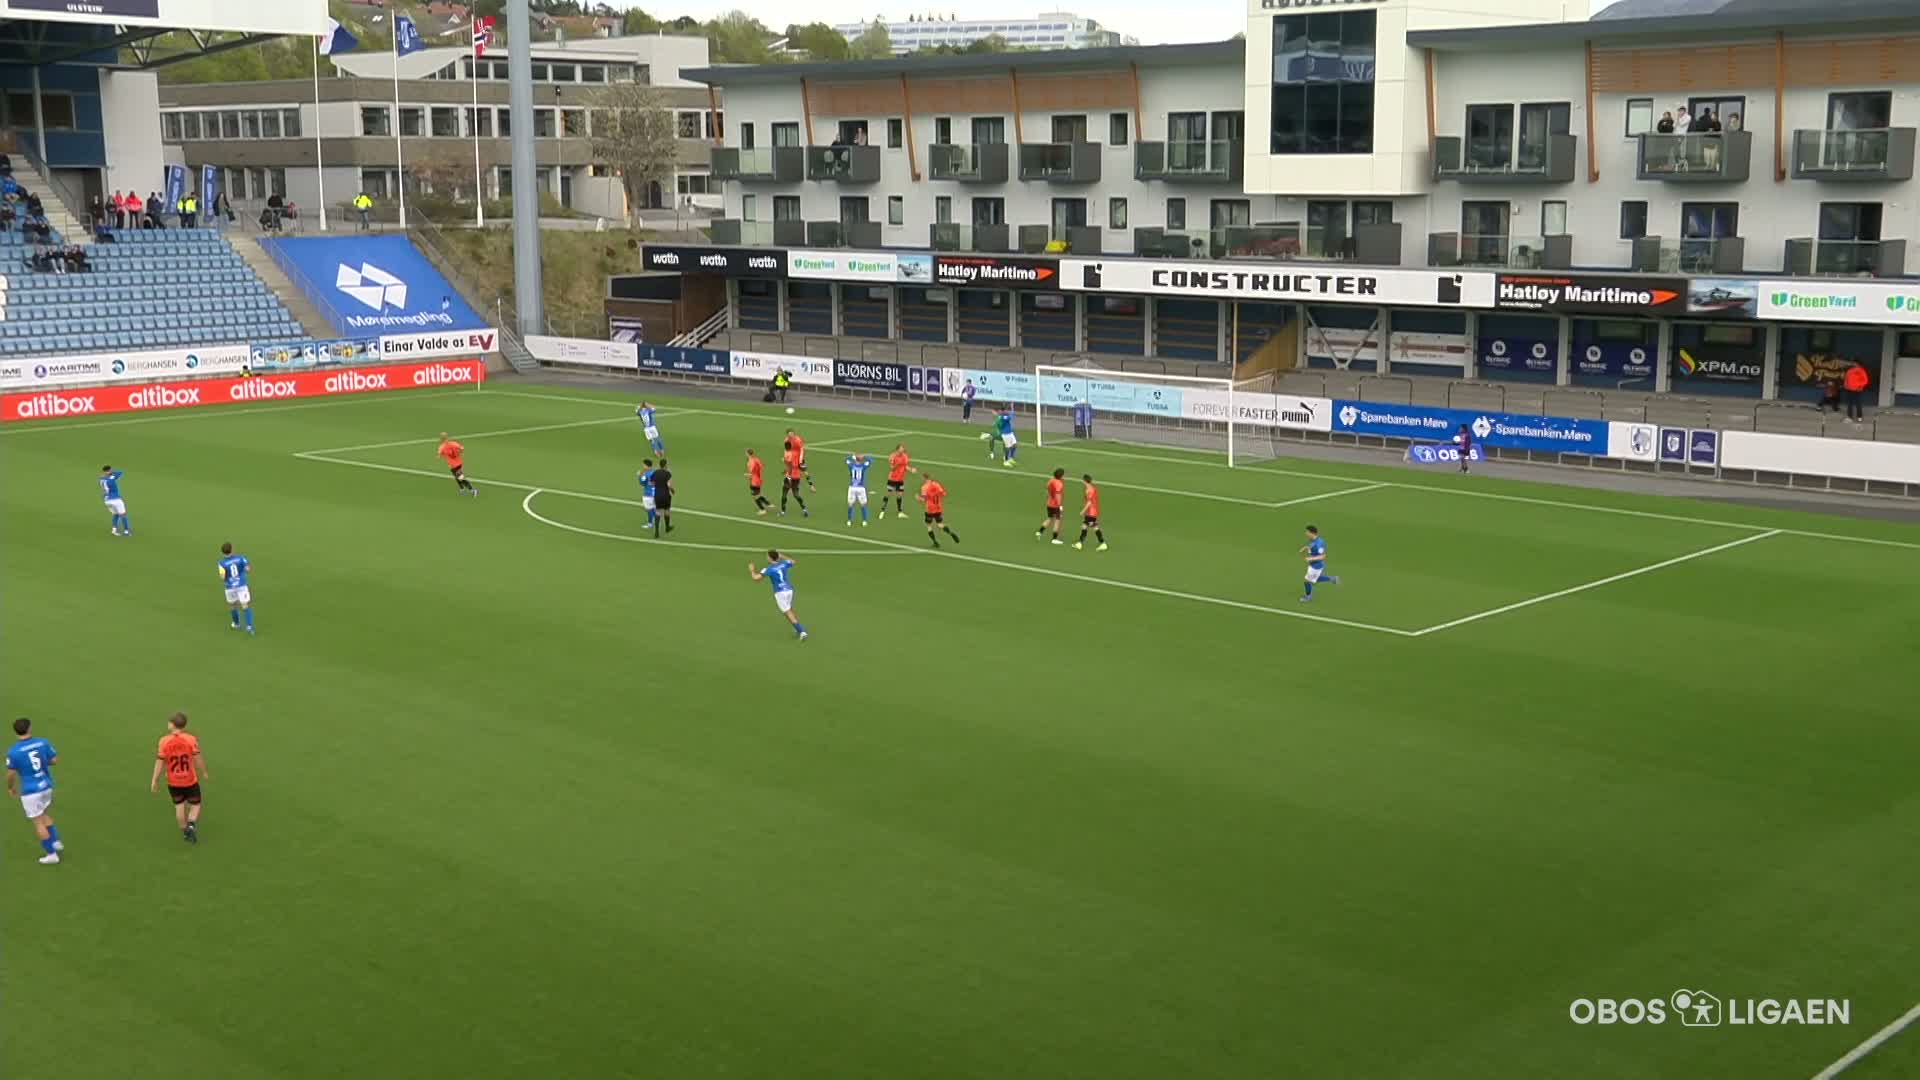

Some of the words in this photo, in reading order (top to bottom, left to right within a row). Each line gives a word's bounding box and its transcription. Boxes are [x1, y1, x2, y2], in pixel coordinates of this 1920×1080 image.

[980, 265, 1036, 280] Maritime
[1152, 269, 1377, 296] CONSTRUCTER
[1499, 284, 1560, 304] Hatløy
[1564, 286, 1651, 304] Maritime
[1790, 294, 1857, 308] GreenYard
[384, 339, 413, 353] Einar
[416, 338, 449, 350] Valde
[452, 339, 465, 349] as
[469, 334, 495, 351] EV
[49, 363, 101, 373] MARITIME
[741, 357, 761, 368] JETS
[810, 363, 830, 375] JETS
[325, 370, 387, 393] altibox
[414, 362, 472, 385] altibox
[837, 363, 882, 380] BJØRNS
[885, 367, 902, 382] BIL
[128, 385, 200, 408] altibox
[230, 377, 296, 400] altibox
[17, 393, 96, 417] altibox
[1240, 407, 1278, 421] FASTER
[1360, 410, 1422, 426] Sparebanken
[1423, 417, 1448, 429] Møre
[1495, 422, 1562, 440] Sparebanken
[1564, 429, 1592, 442] Møre
[1438, 449, 1479, 460] OBS
[170, 753, 190, 773] 26
